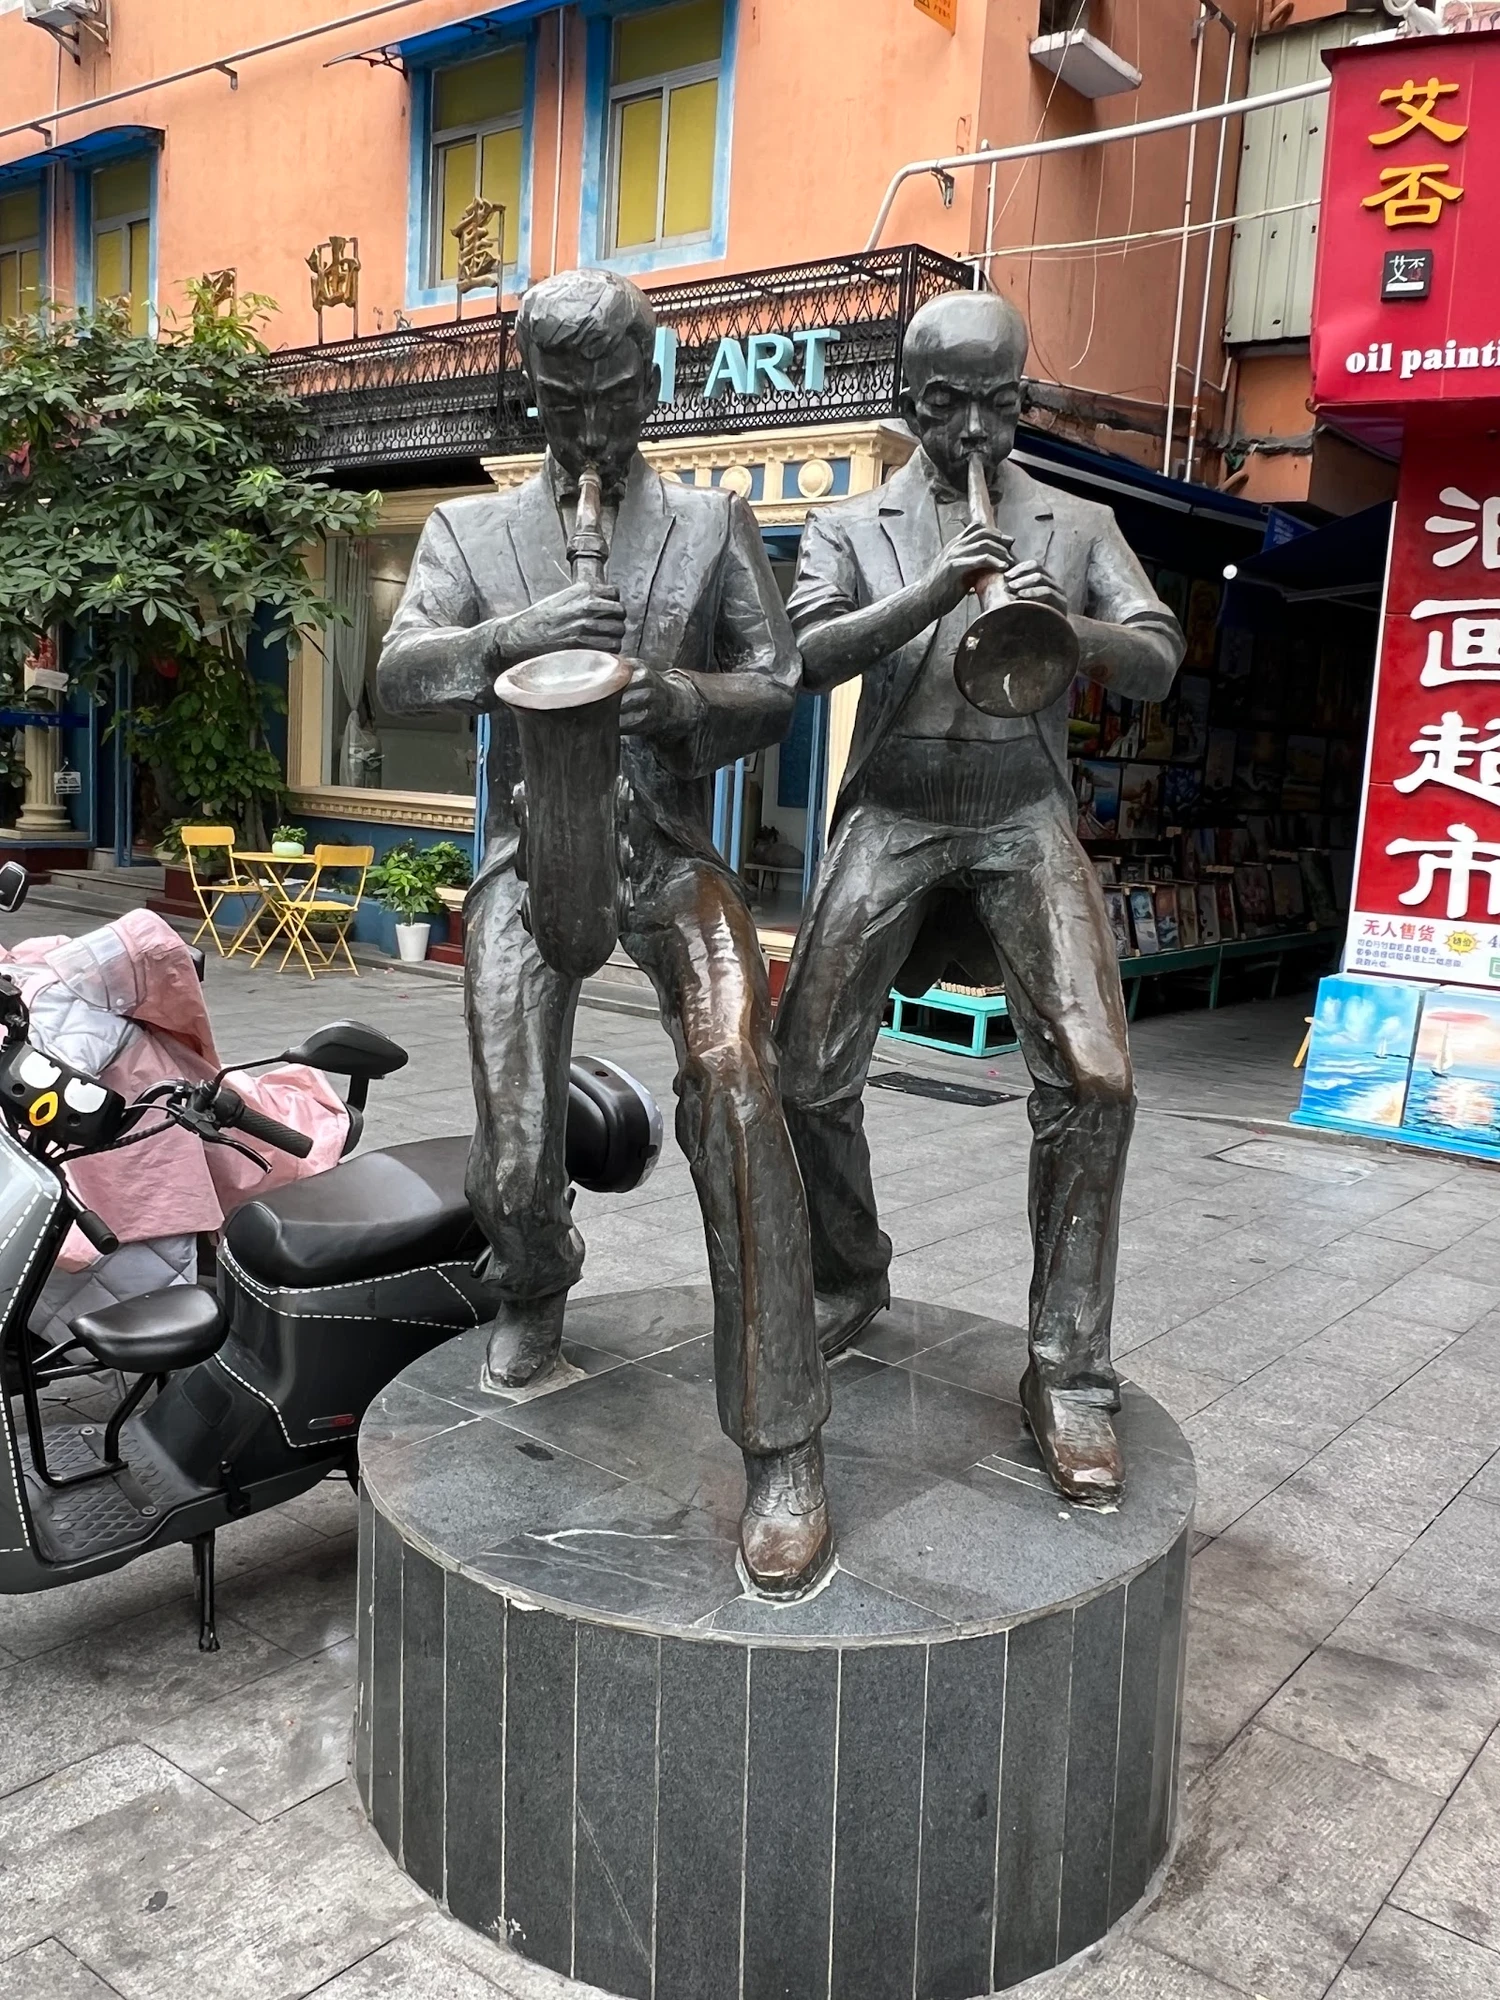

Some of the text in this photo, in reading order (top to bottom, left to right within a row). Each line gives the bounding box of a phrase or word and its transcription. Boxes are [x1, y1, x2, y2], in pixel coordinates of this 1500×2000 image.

[1360, 77, 1468, 229] 艾否
[703, 328, 841, 399] ART
[1345, 342, 1393, 374] oil
[1362, 919, 1435, 943] 无人售货
